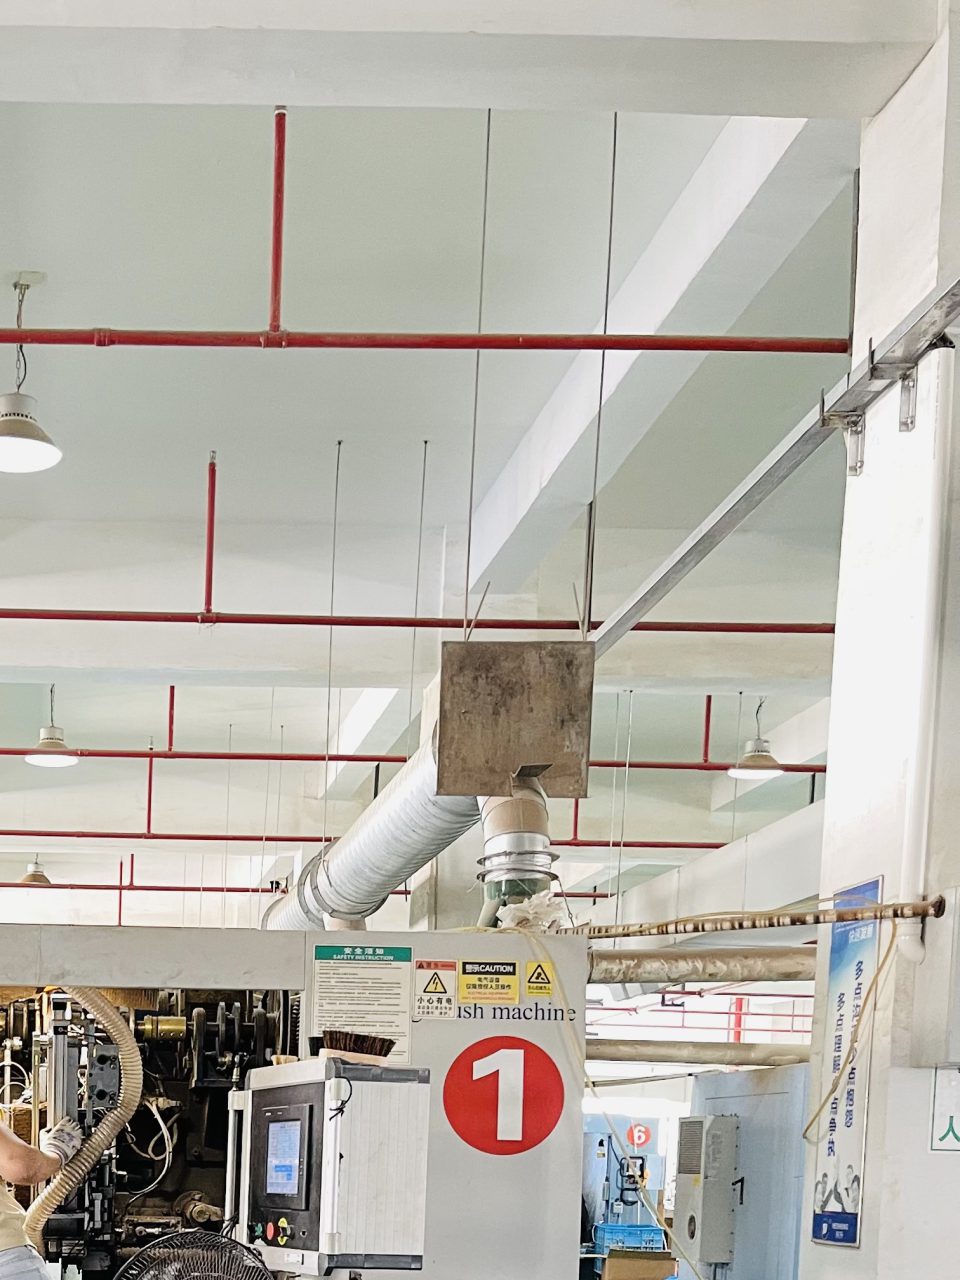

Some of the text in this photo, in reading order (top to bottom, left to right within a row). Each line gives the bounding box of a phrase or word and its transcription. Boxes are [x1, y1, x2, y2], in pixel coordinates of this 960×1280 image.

[417, 997, 453, 1005] 小心有电
[492, 1002, 577, 1021] machine
[472, 1049, 525, 1141] 1
[634, 1126, 646, 1144] 6
